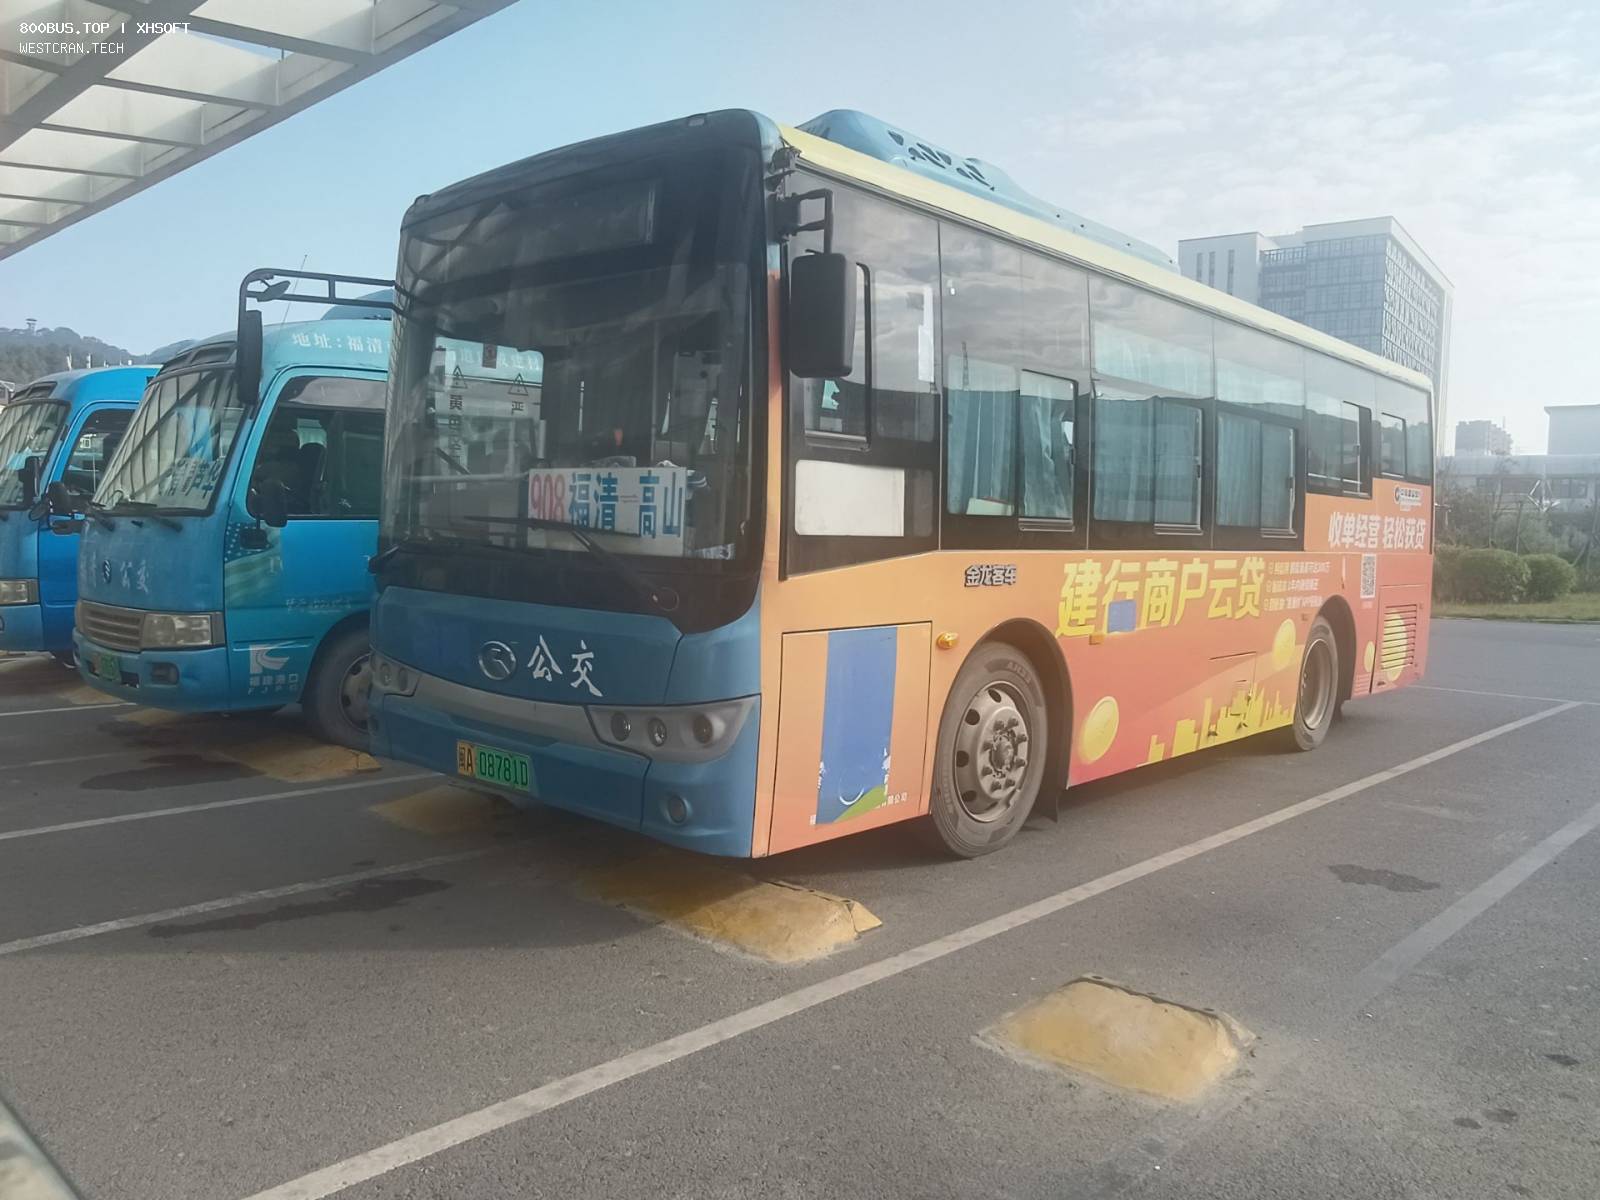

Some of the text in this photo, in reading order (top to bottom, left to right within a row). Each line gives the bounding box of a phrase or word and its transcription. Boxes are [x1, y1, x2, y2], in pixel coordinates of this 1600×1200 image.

[531, 473, 566, 522] 908
[639, 469, 684, 541] 高山
[1328, 512, 1427, 550] 收单经营 轻松获贷
[964, 564, 1017, 588] 金龙客车
[1056, 557, 1265, 636] 建行商户云贷
[527, 634, 604, 697] 公交
